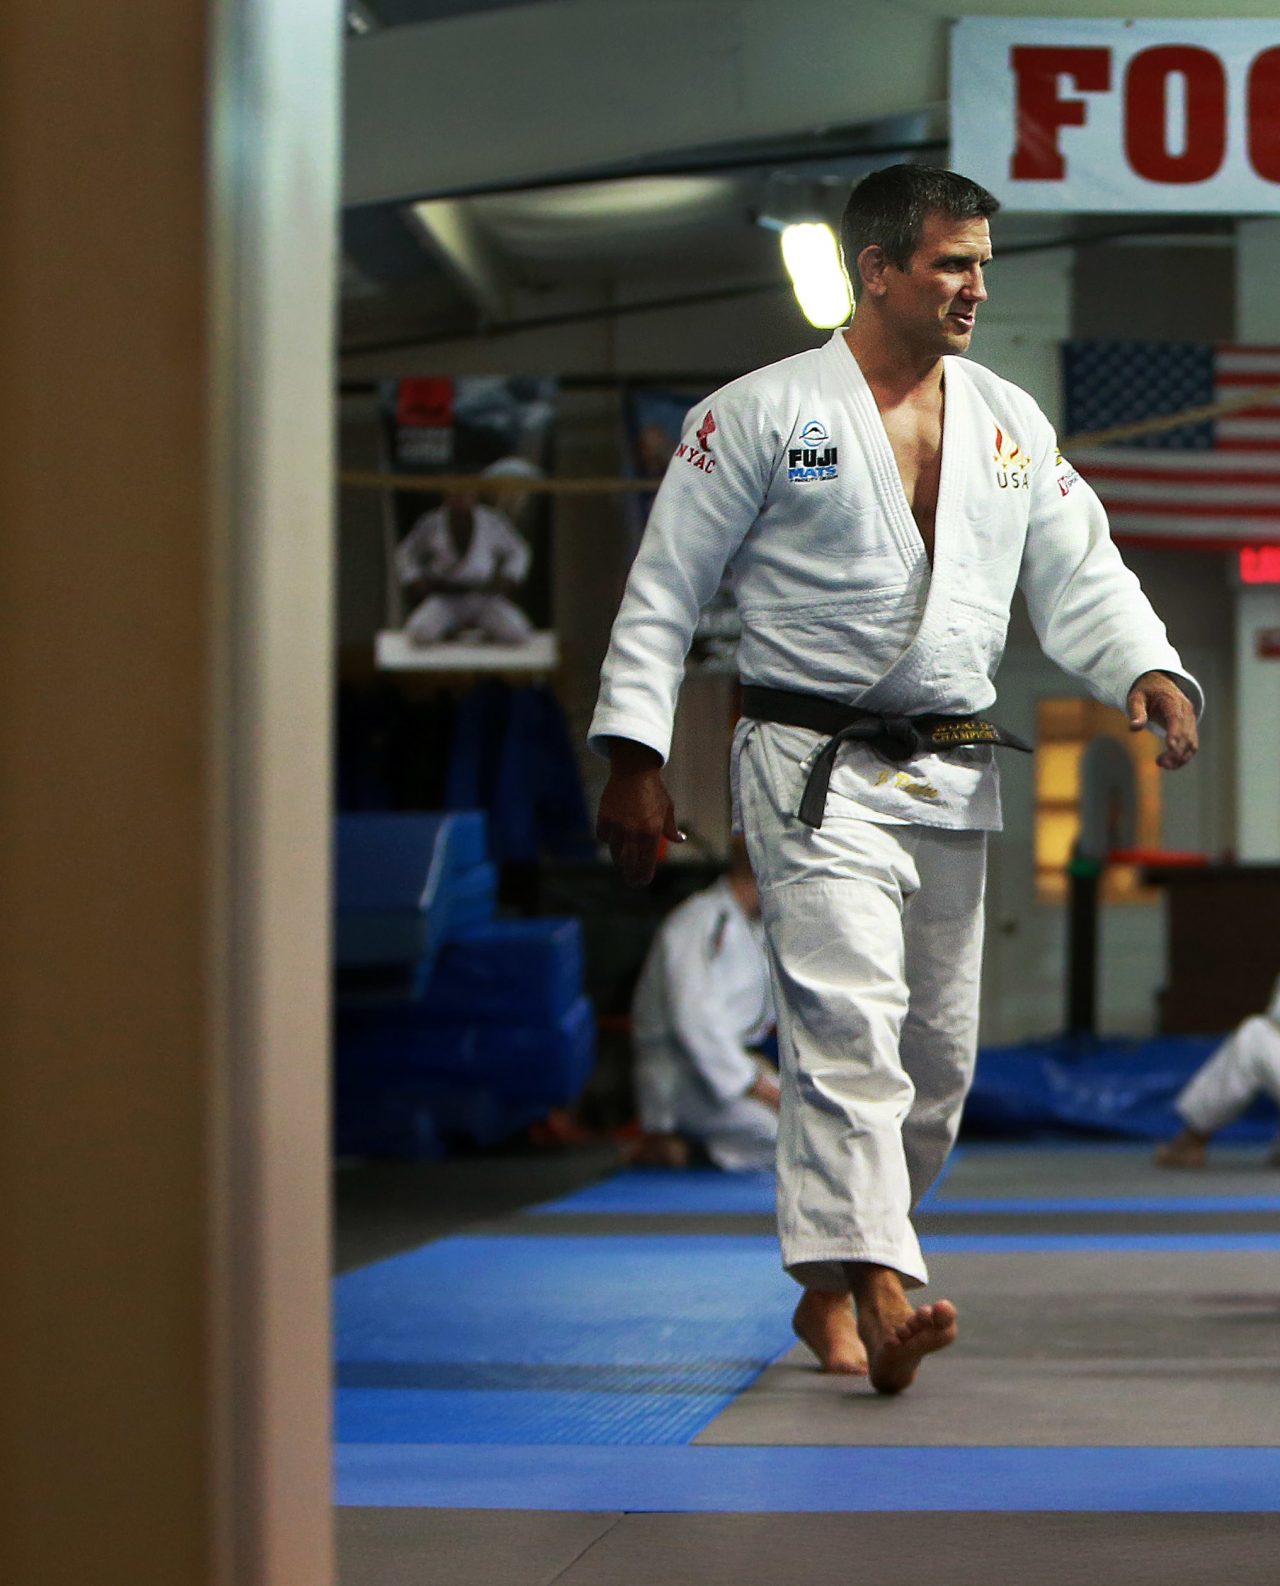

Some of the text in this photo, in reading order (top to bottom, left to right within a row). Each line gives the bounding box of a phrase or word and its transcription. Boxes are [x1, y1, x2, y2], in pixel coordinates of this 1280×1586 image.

[676, 443, 716, 474] NYAC
[788, 447, 838, 468] FUJI
[787, 466, 838, 480] MATS
[996, 472, 1030, 489] USA
